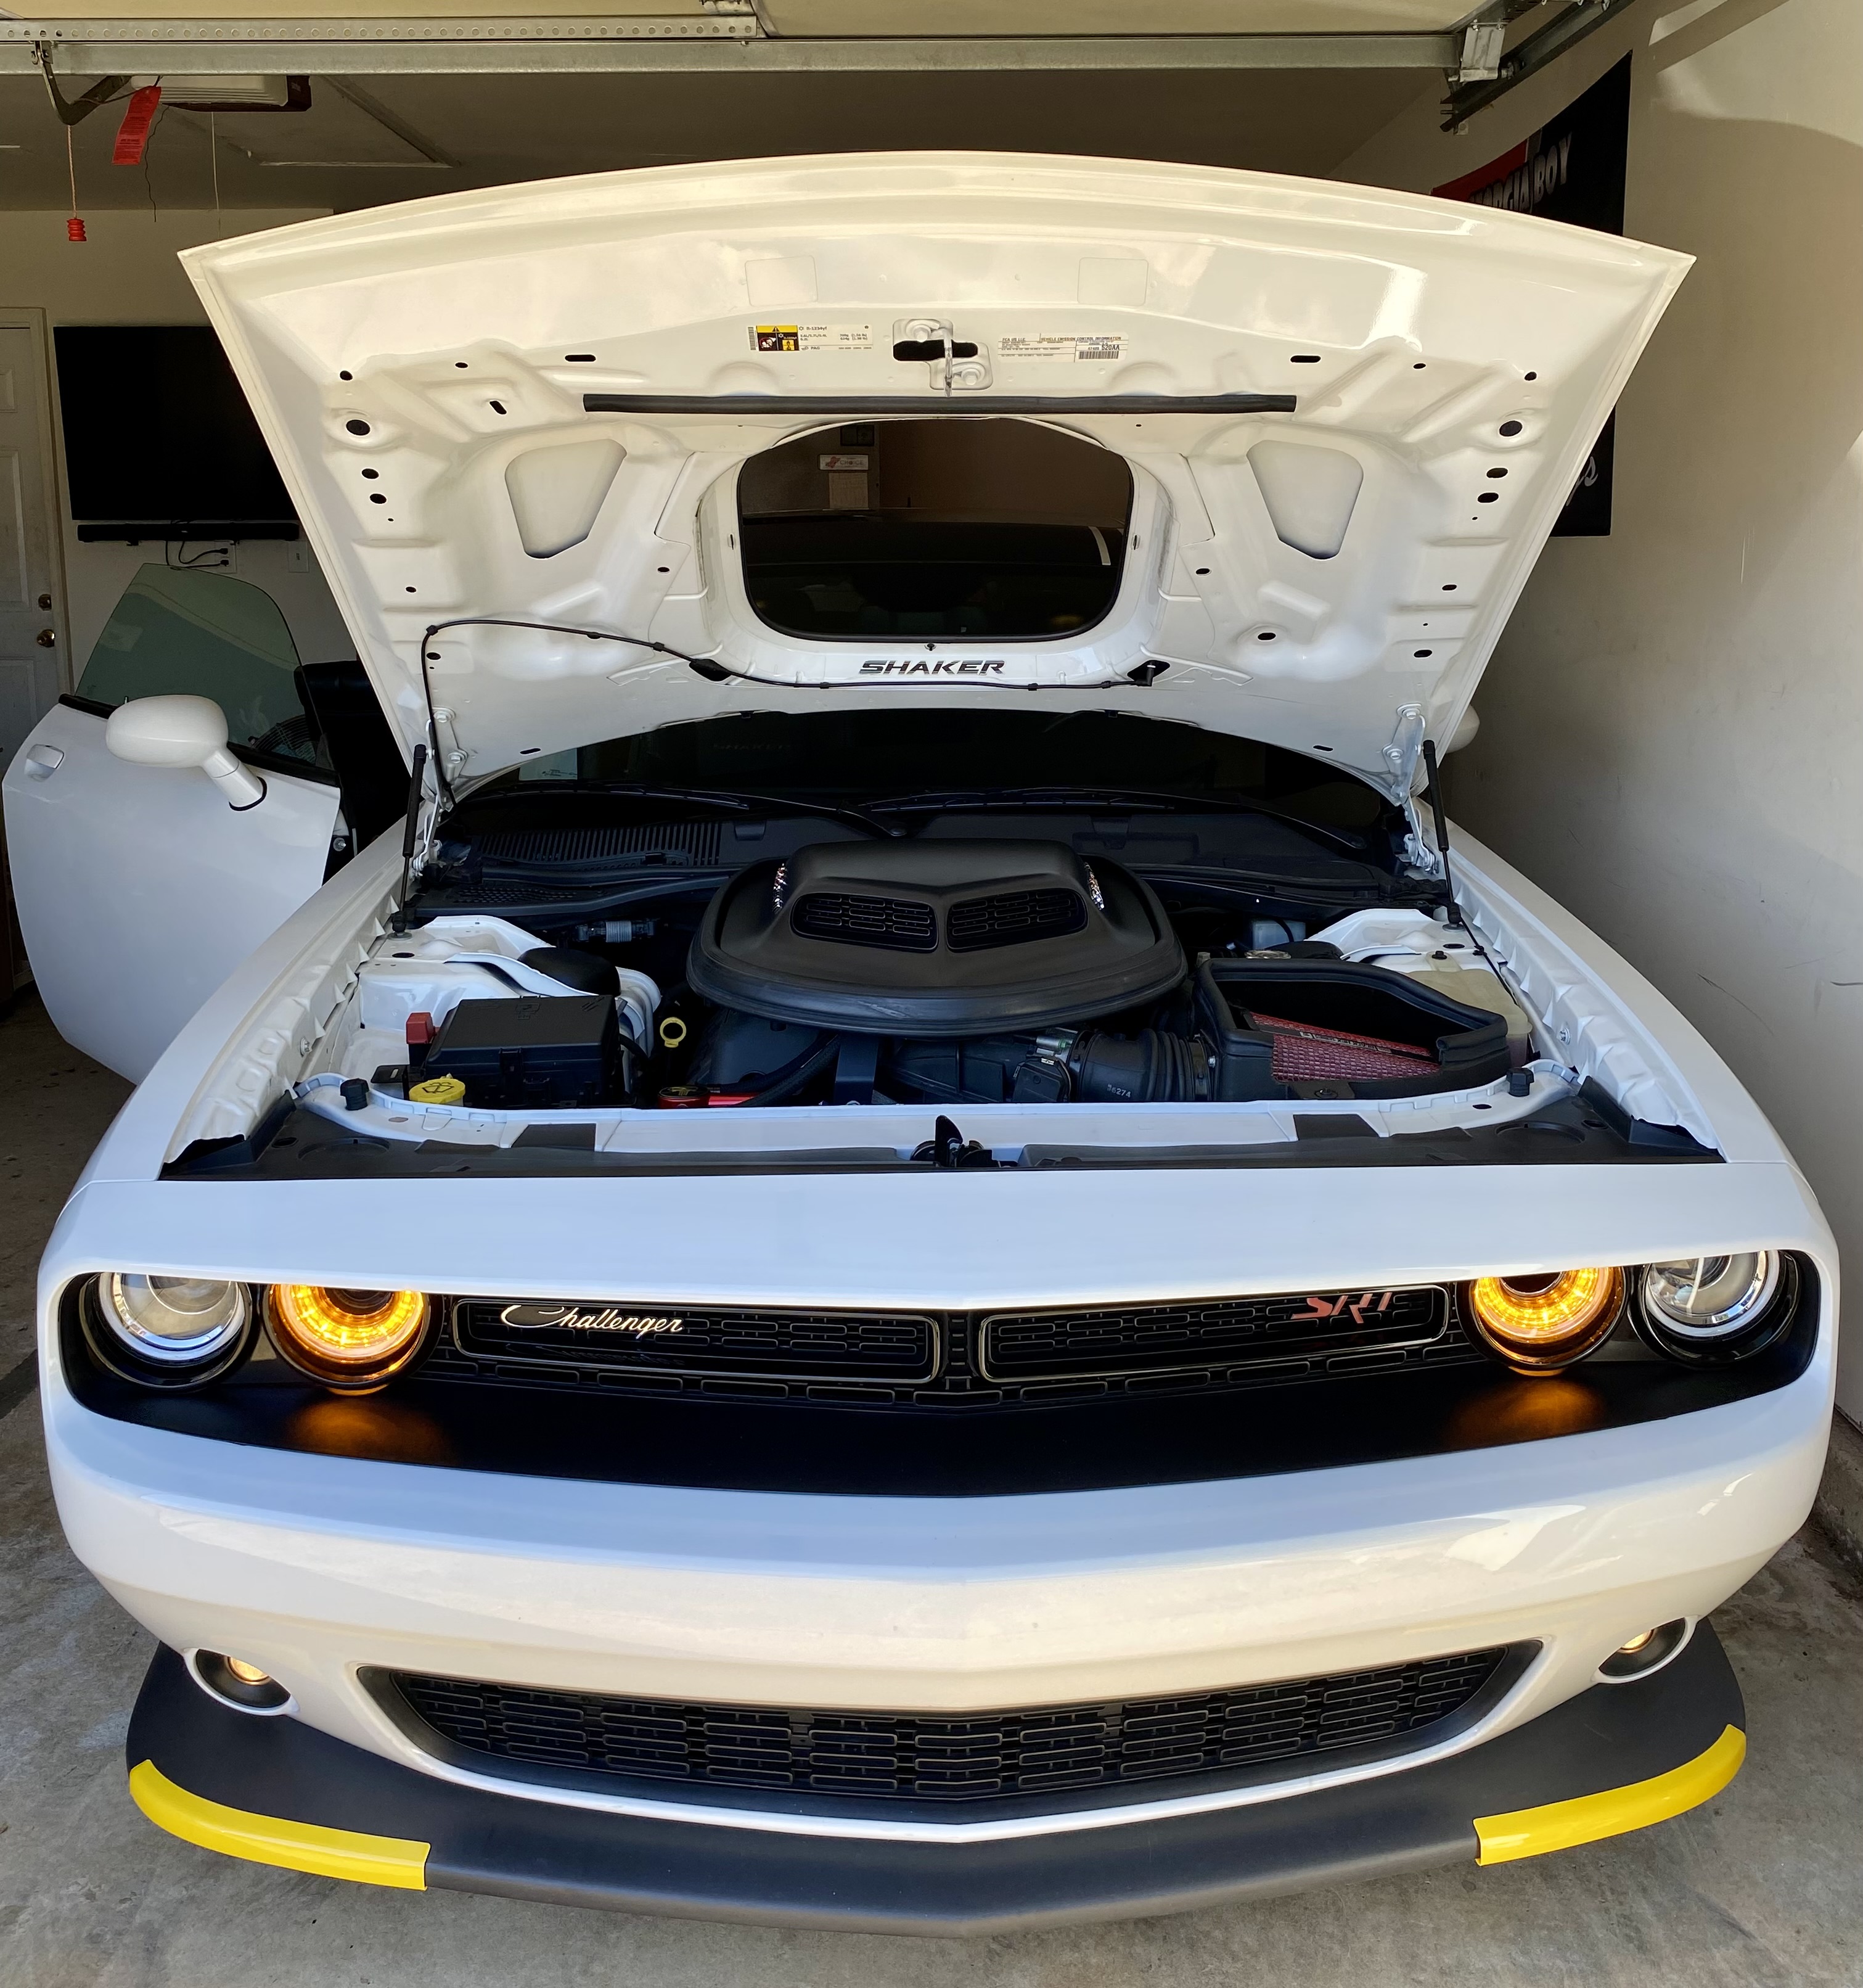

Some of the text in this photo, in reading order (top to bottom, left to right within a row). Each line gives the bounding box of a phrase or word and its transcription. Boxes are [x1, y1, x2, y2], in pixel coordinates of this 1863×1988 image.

[1534, 131, 1572, 204] BOY
[859, 660, 1006, 676] SHAKER
[501, 1304, 684, 1340] Challenger
[1290, 1292, 1393, 1324] SRT
